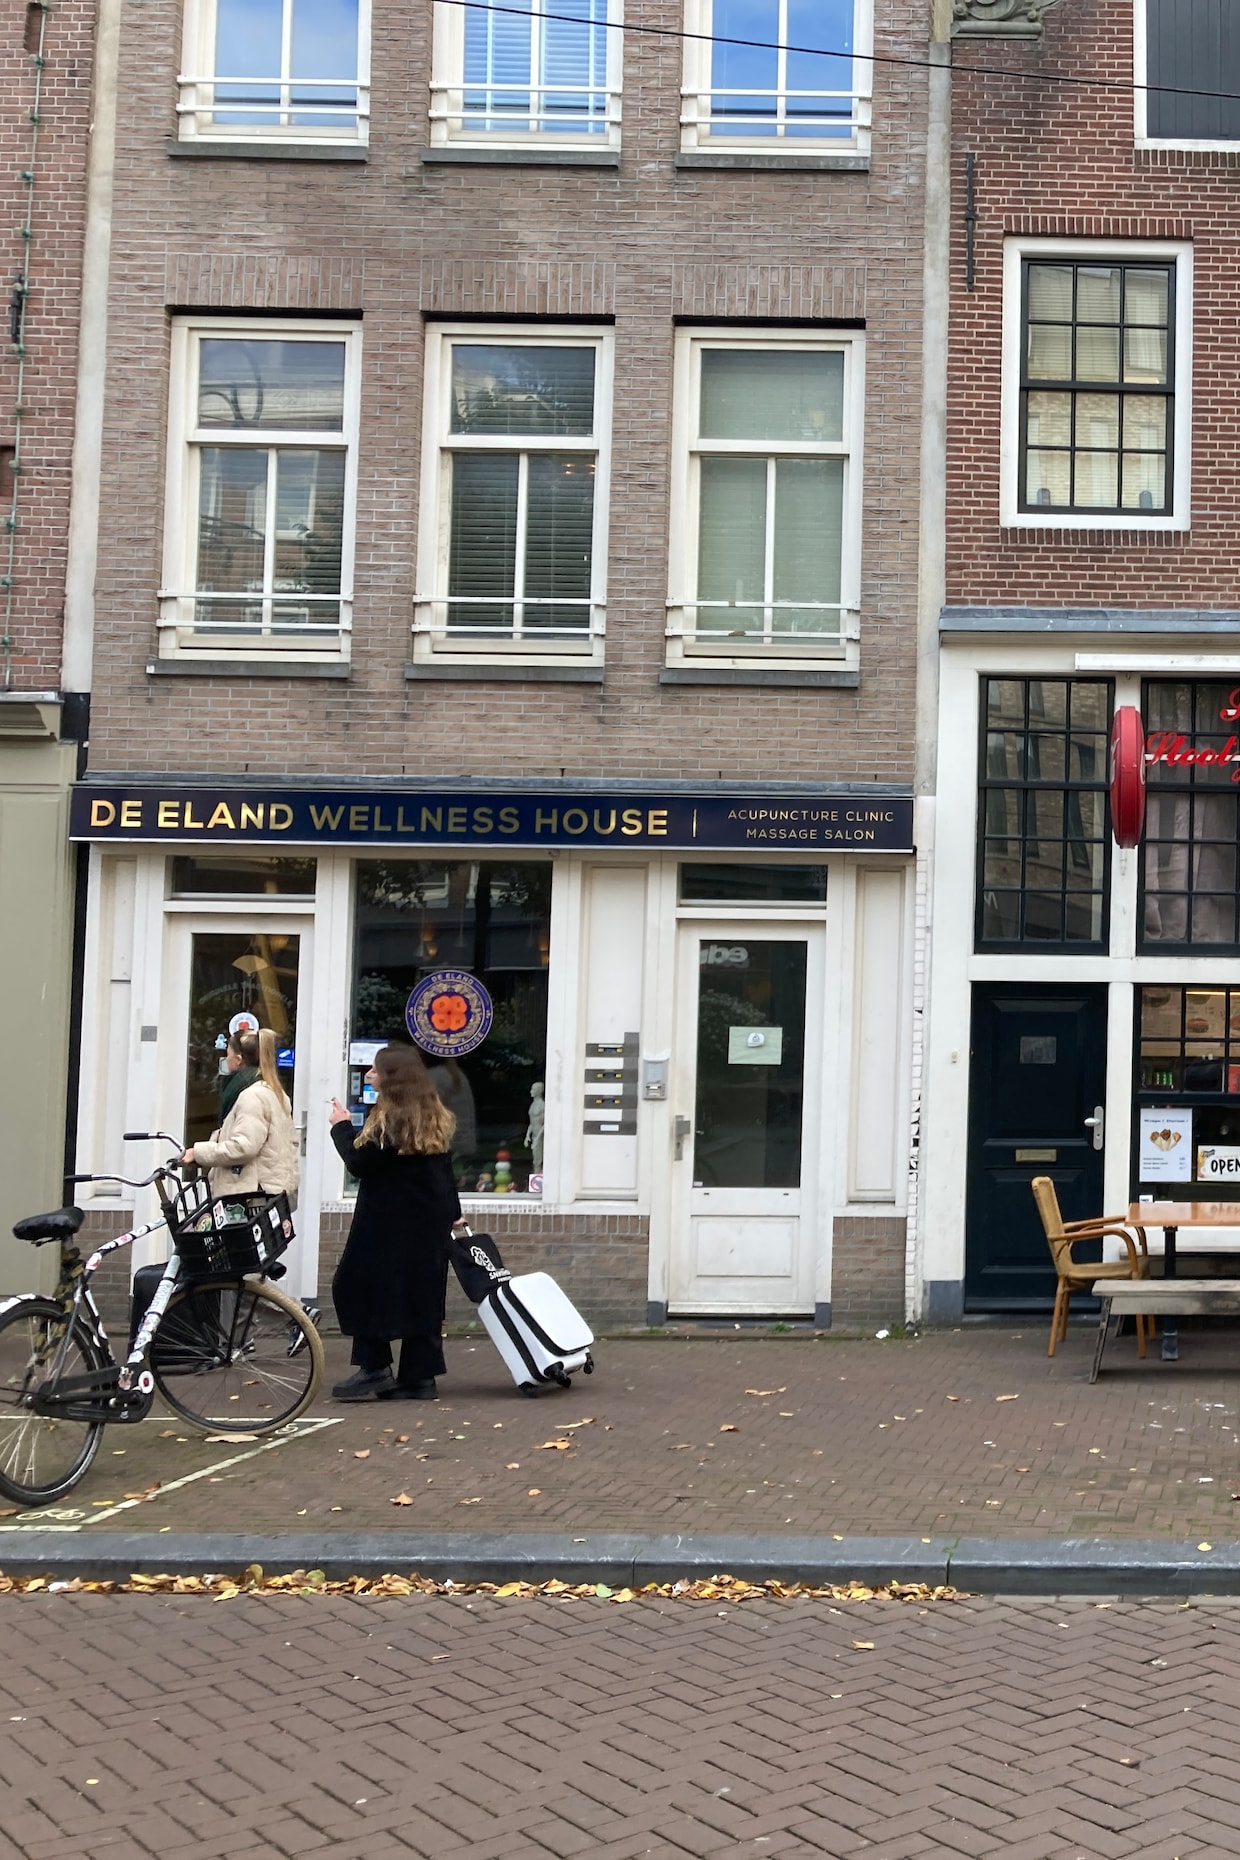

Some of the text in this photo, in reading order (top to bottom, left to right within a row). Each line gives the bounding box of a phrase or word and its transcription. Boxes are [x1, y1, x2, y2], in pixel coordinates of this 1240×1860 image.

[89, 800, 668, 836] DE ELAND WELLNESS HOUSE
[727, 808, 895, 823] ACUPUNCTURE CLINIC
[745, 827, 876, 841] MASSAGE SALON
[430, 972, 474, 985] DE ELAND
[413, 1030, 456, 1055] WELLNESS
[457, 1032, 485, 1053] HOUSE
